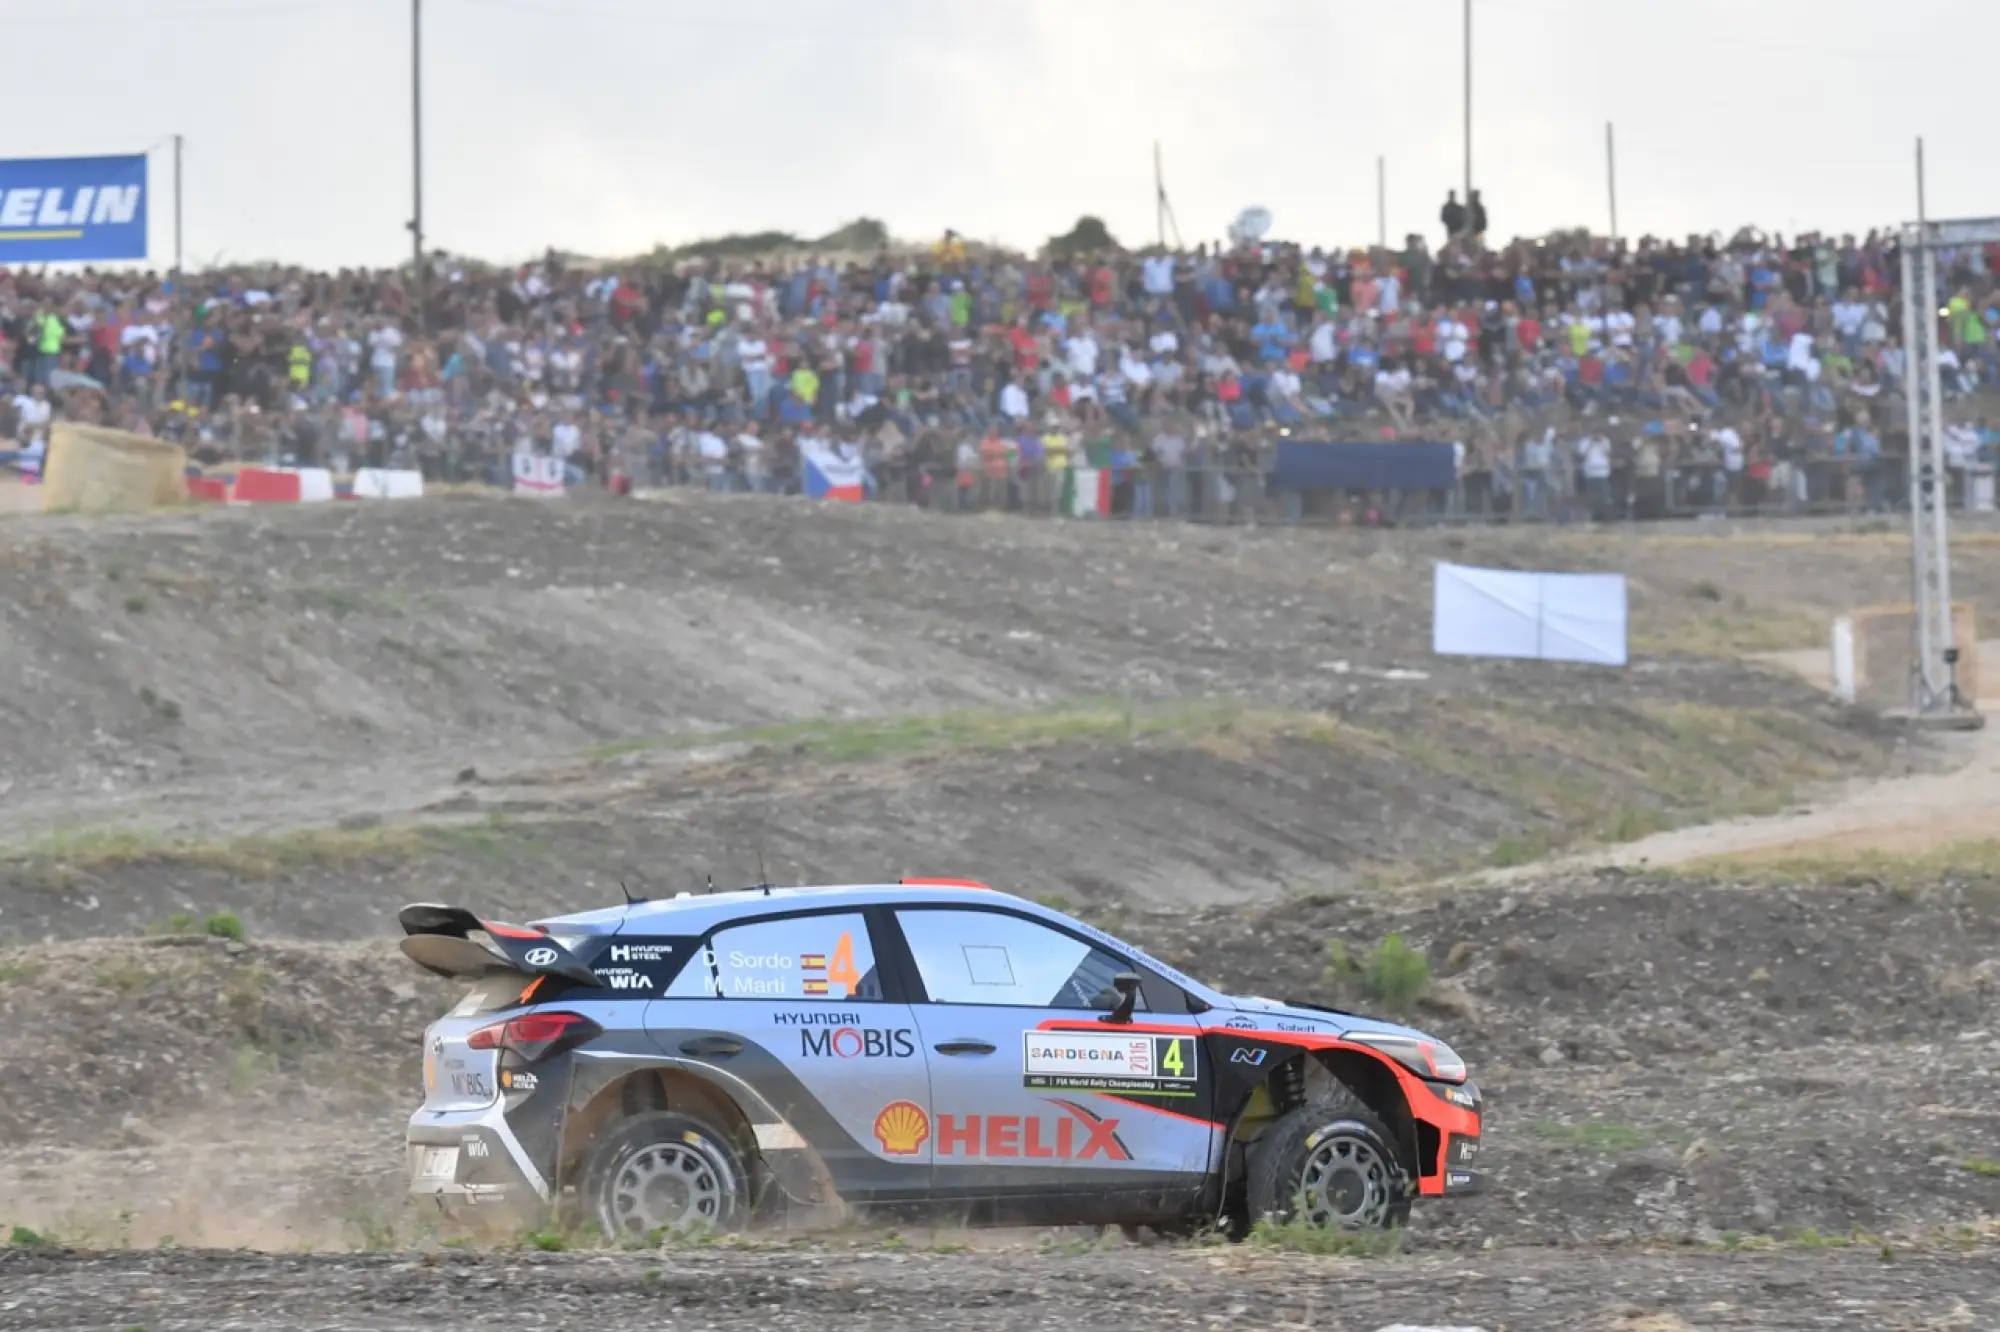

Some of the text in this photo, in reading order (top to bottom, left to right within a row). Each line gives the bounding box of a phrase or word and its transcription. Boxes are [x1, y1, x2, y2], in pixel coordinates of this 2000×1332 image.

[0, 184, 140, 227] ELIN
[631, 953, 662, 961] STEEL
[729, 950, 793, 970] Sordo
[828, 930, 861, 995] 4
[734, 976, 786, 995] Marti
[773, 1012, 861, 1025] HYUNDAI
[800, 1027, 915, 1059] MOBIS
[1031, 1047, 1125, 1062] SARDEGNA
[1129, 1041, 1149, 1073] 2016
[1163, 1038, 1185, 1078] 4
[1090, 1078, 1107, 1089] Rally
[1108, 1079, 1156, 1090] Championship
[936, 1097, 1135, 1161] HELIX
